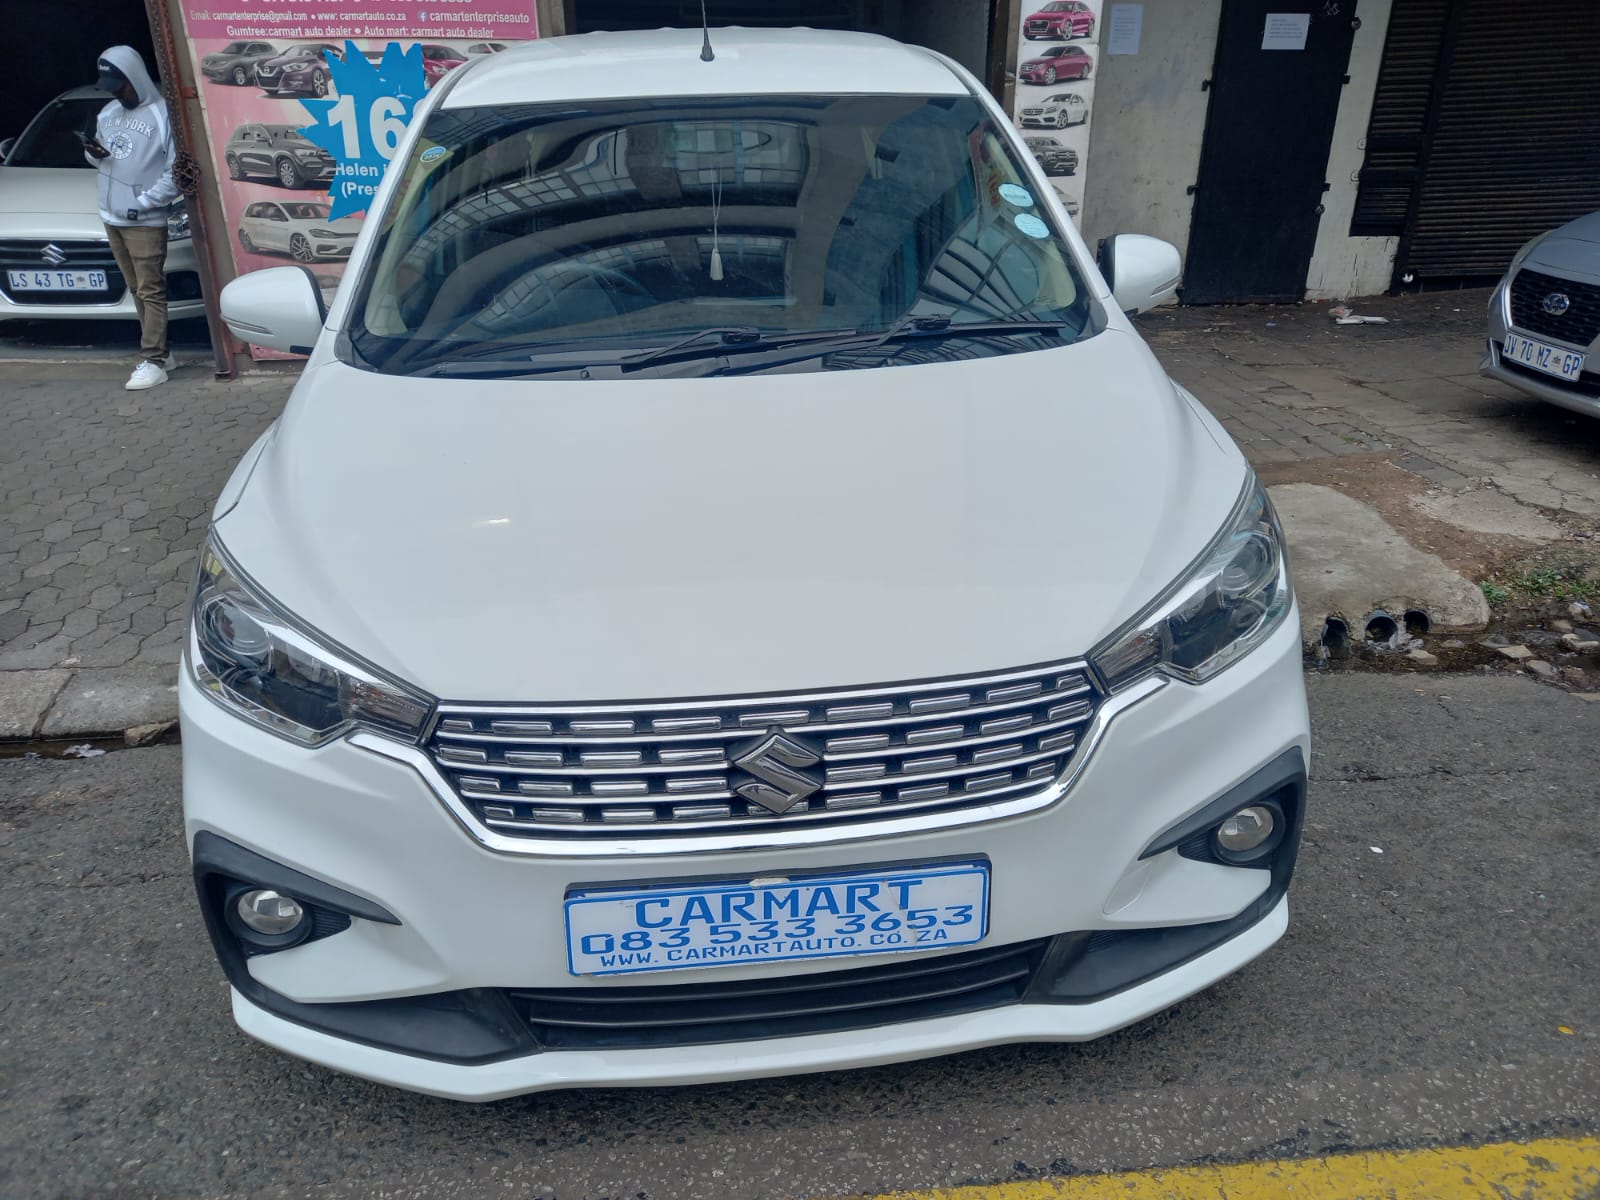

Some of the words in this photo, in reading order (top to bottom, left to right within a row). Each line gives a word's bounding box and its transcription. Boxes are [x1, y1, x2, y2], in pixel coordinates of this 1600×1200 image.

[429, 11, 529, 24] carmartenterpriseauto
[304, 26, 323, 36] auto
[325, 25, 352, 37] dealer
[364, 25, 384, 36] Auto
[386, 26, 409, 37] mart:
[411, 27, 445, 37] carmart
[446, 27, 465, 37] auto
[467, 26, 494, 38] dealer
[126, 117, 155, 138] YORK
[327, 94, 427, 161] 16
[335, 162, 379, 177] Helen
[10, 273, 28, 288] LS
[34, 273, 51, 288] 43
[57, 273, 75, 288] TG
[88, 272, 105, 288] GP
[1504, 335, 1518, 356] JV
[1520, 340, 1534, 362] 70
[1535, 345, 1552, 368] MZ
[1562, 354, 1580, 376] GP
[635, 879, 923, 929] CARMART
[581, 927, 691, 955] 083
[709, 917, 816, 945] 533
[834, 904, 974, 935] 3653
